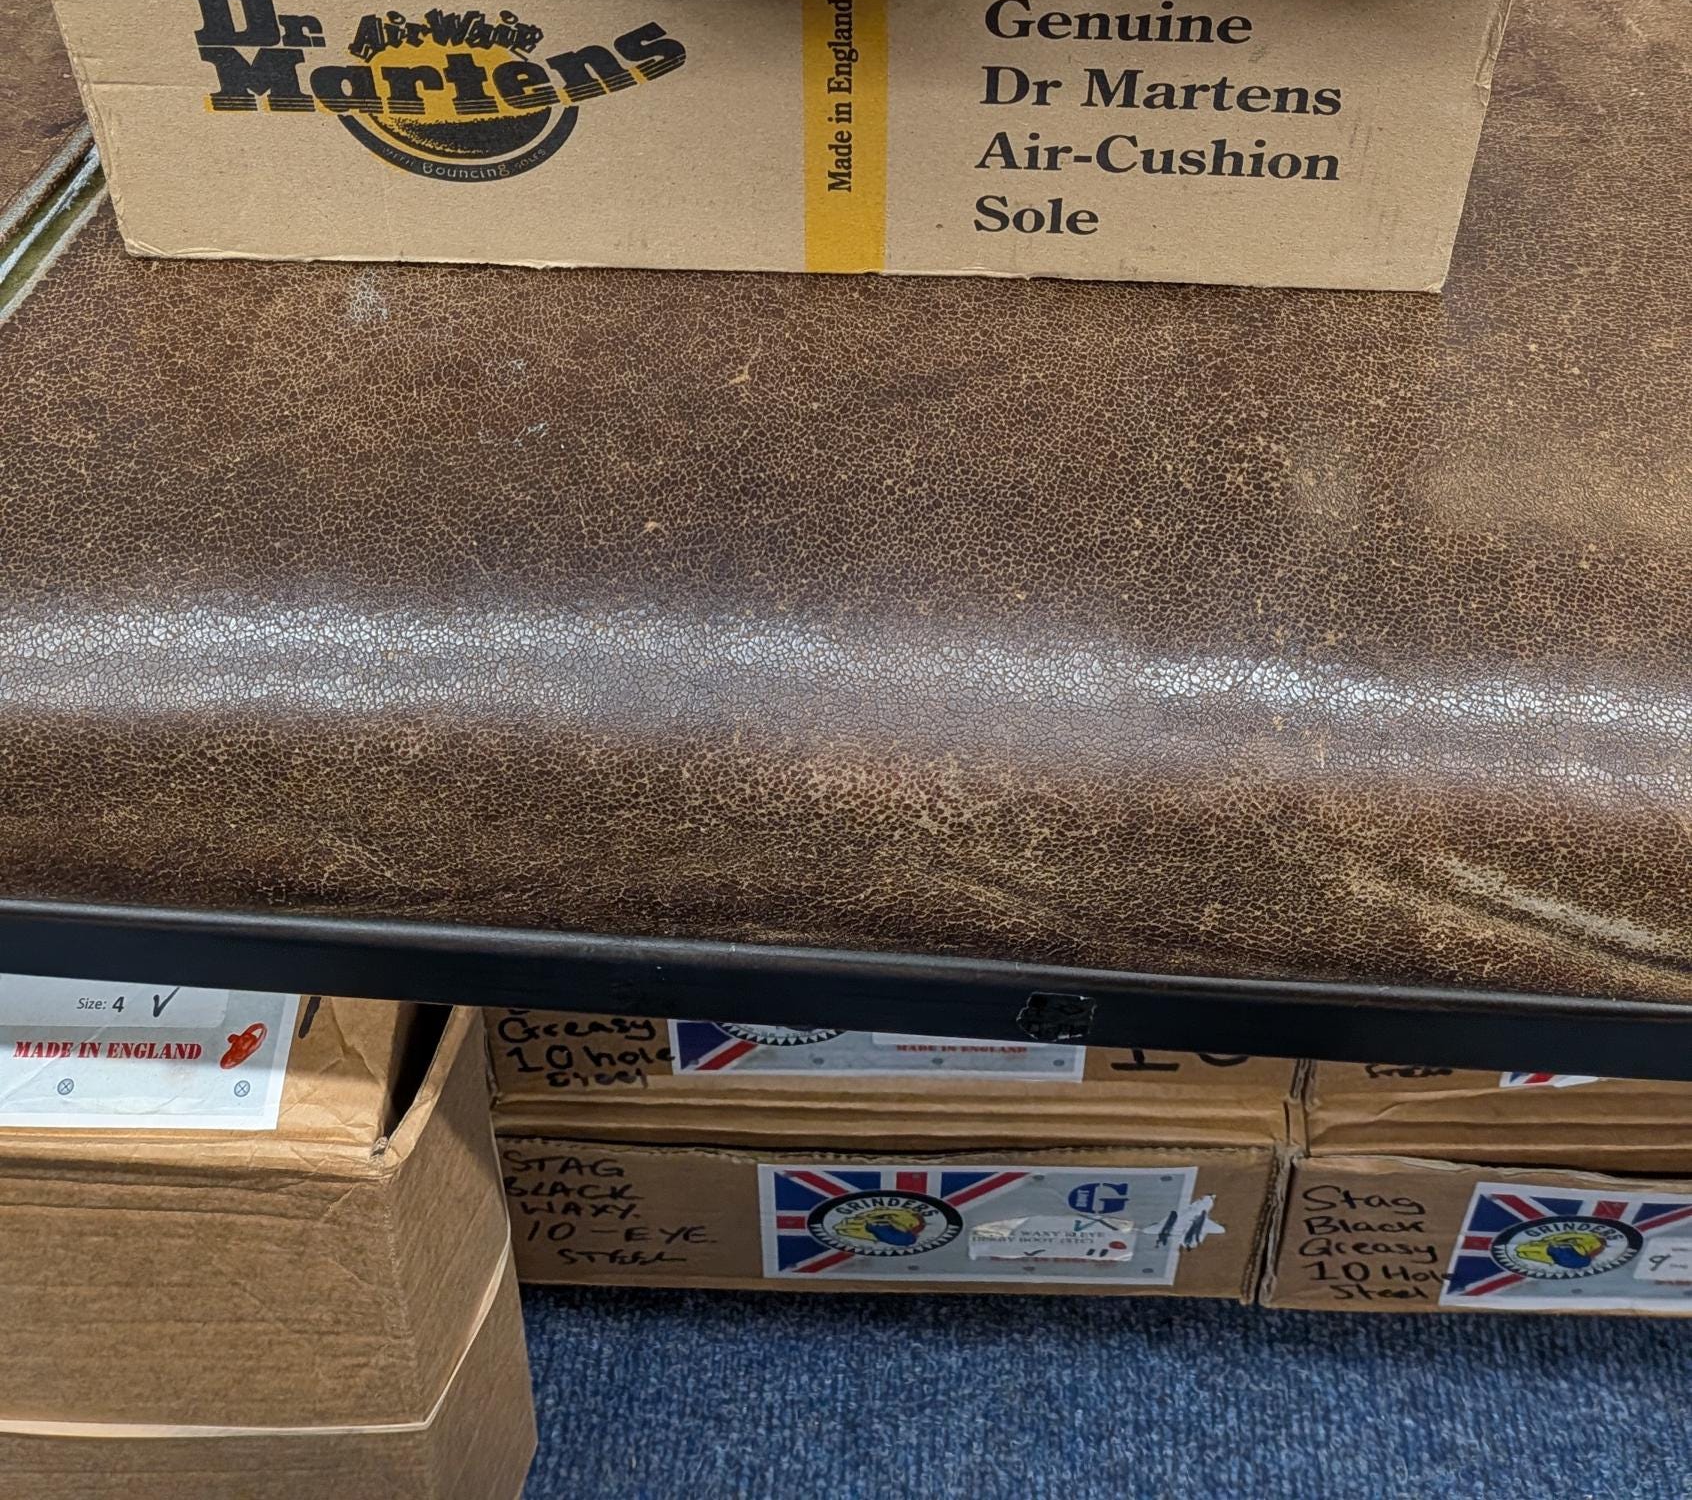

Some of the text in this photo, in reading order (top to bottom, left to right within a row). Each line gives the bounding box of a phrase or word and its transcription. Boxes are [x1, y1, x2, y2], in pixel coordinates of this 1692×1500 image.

[348, 7, 544, 63] AirWair
[201, 20, 687, 114] Martens
[980, 64, 1343, 117] Dr Martens
[827, 100, 853, 125] in
[827, 129, 853, 194] Made
[974, 130, 1340, 182] Air-Cushion
[422, 162, 511, 180] Bouncing
[973, 195, 1099, 236] Sole
[76, 996, 125, 1013] Size: 4
[498, 1017, 657, 1044] Greasy
[13, 1040, 203, 1061] MADE IN ENGLAND
[507, 1045, 574, 1072] 10
[503, 1150, 625, 1178] STAG
[504, 1175, 645, 1200] BLACK
[1302, 1184, 1426, 1215] Stag
[835, 1196, 940, 1218] GRINDERS
[1303, 1215, 1425, 1236] Black
[1526, 1221, 1624, 1241] GRINDERS
[1299, 1237, 1438, 1265] Greasy
[1301, 1261, 1370, 1282] 10
